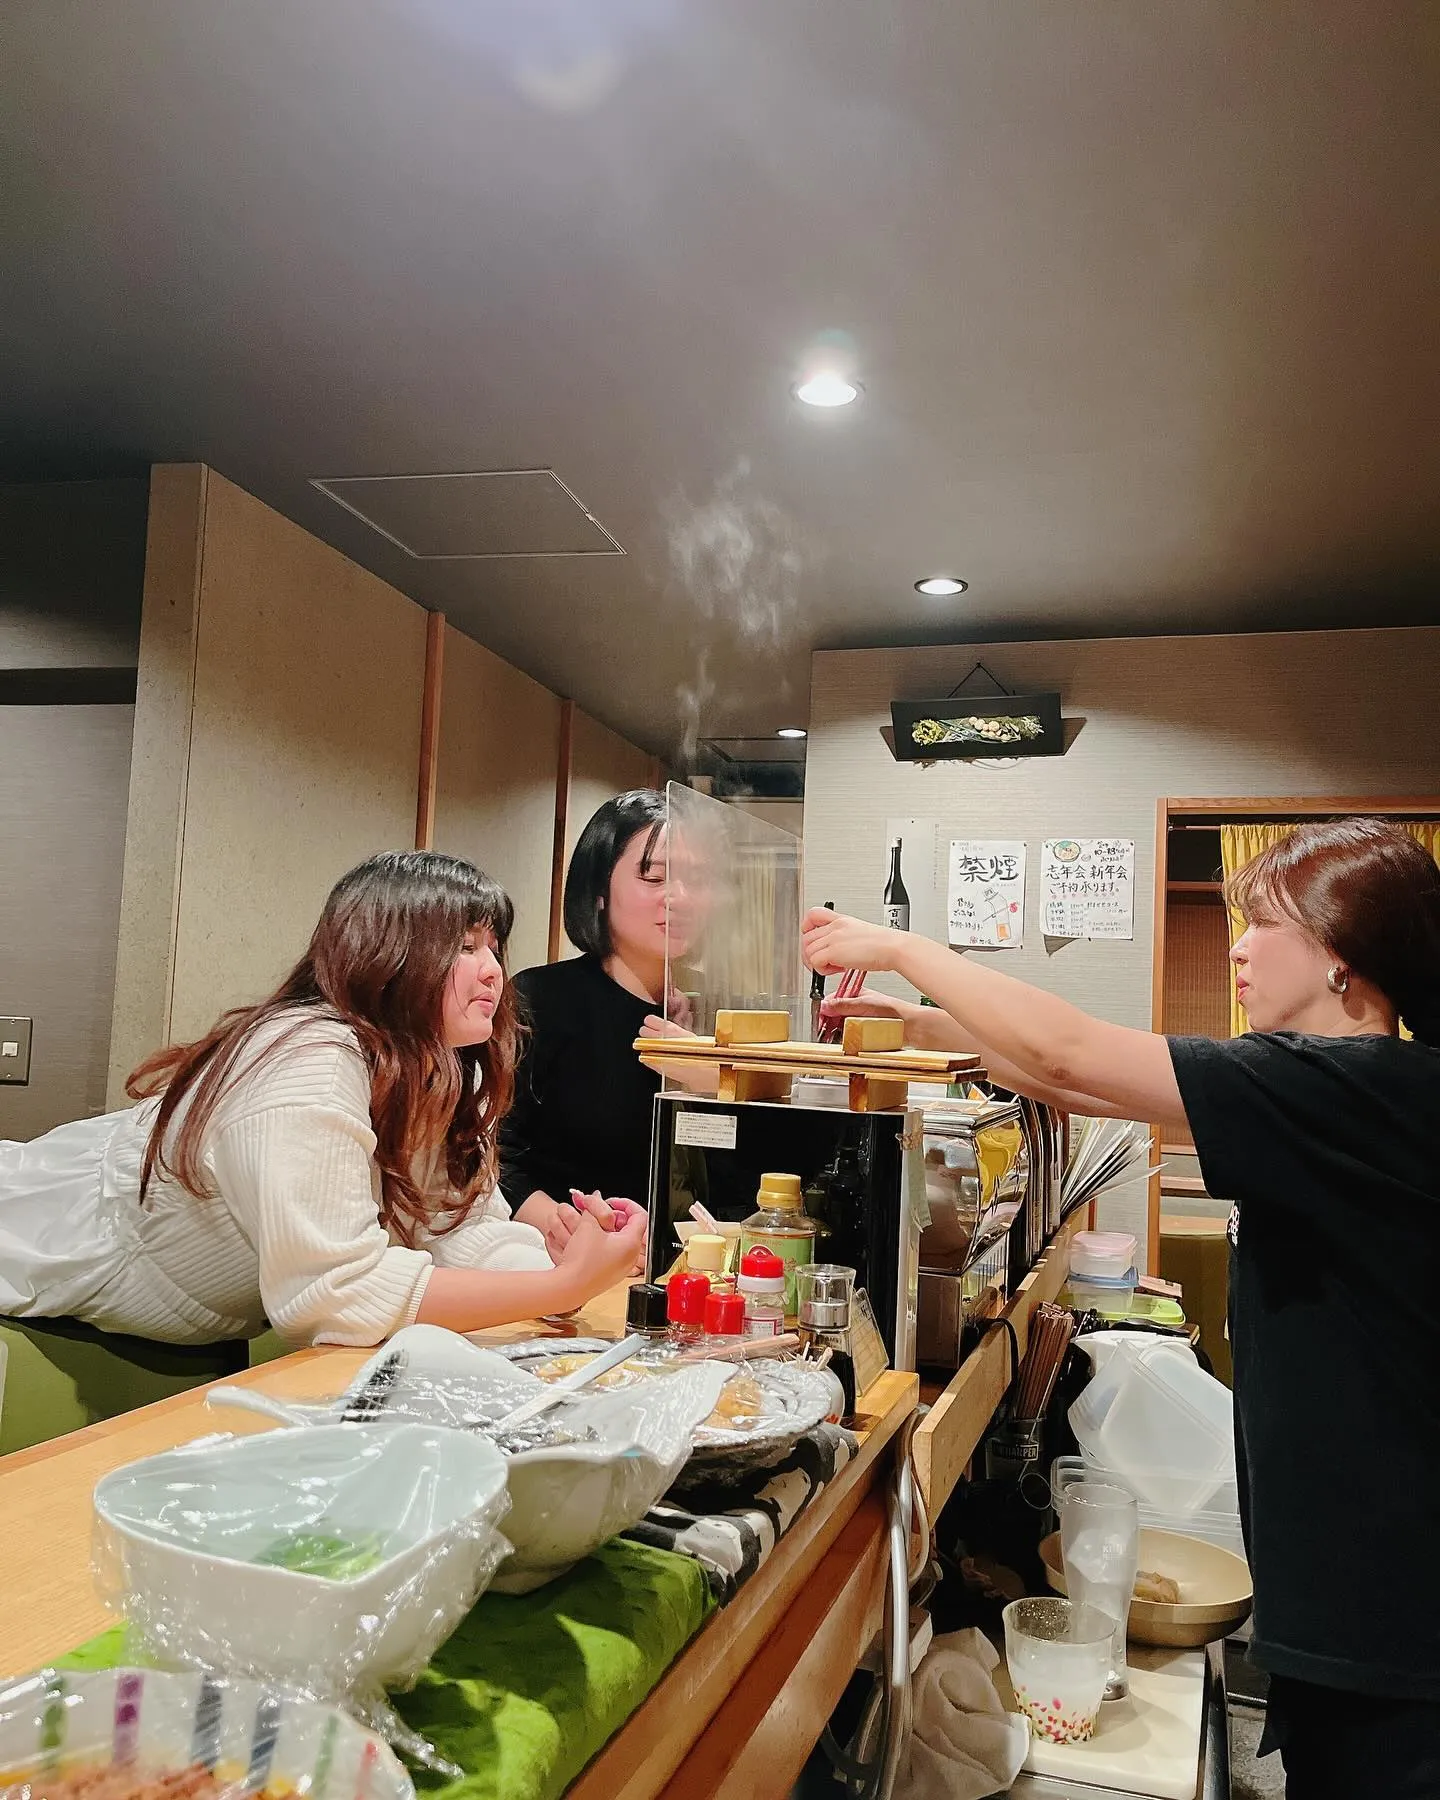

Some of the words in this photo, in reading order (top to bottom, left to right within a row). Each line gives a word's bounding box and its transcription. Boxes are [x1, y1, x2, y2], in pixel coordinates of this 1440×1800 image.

[958, 854, 1019, 882] 禁煙
[1046, 865, 1087, 880] 忘年会
[1089, 865, 1128, 880] 新年会
